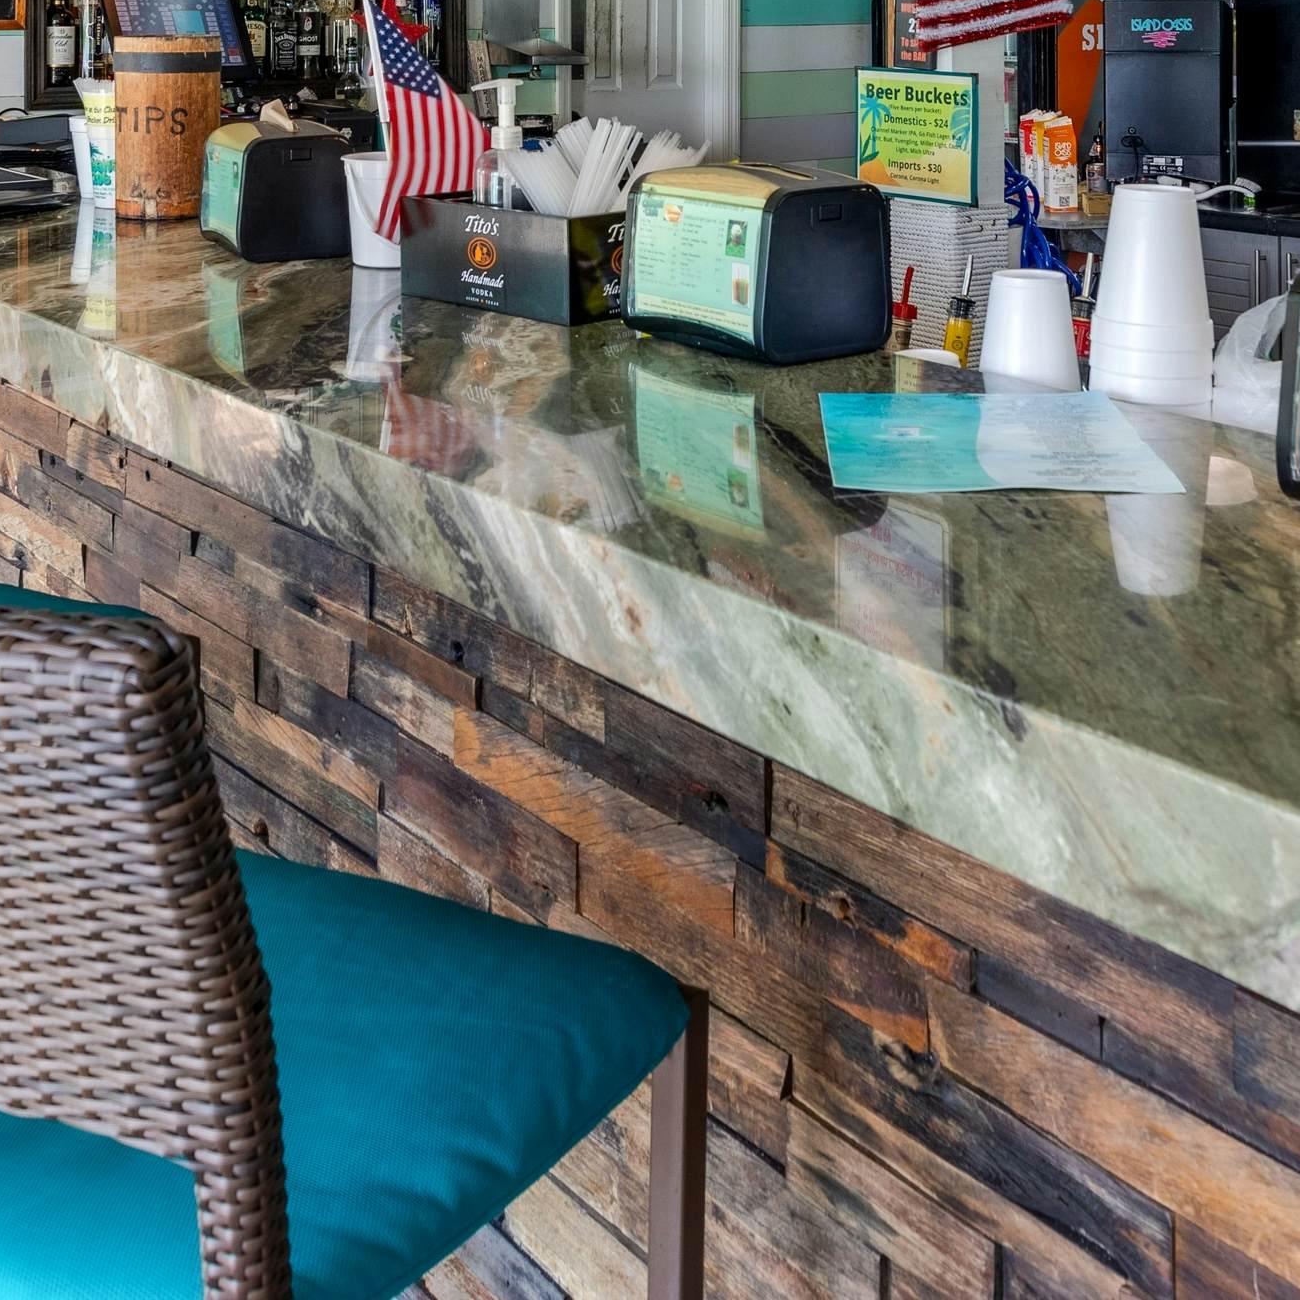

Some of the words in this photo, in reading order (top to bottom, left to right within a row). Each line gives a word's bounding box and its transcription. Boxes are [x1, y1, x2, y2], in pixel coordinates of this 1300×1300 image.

[901, 52, 912, 60] the
[866, 83, 901, 100] Beer
[905, 86, 968, 106] Buckets
[116, 106, 188, 135] TIPS
[884, 114, 927, 126] Domestics
[934, 119, 949, 129] $24
[923, 148, 935, 156] Ultra
[888, 159, 921, 171] Imports
[927, 163, 942, 173] $30
[465, 214, 499, 236] Tito's
[460, 269, 504, 288] Handmade
[471, 288, 493, 298] VODKA
